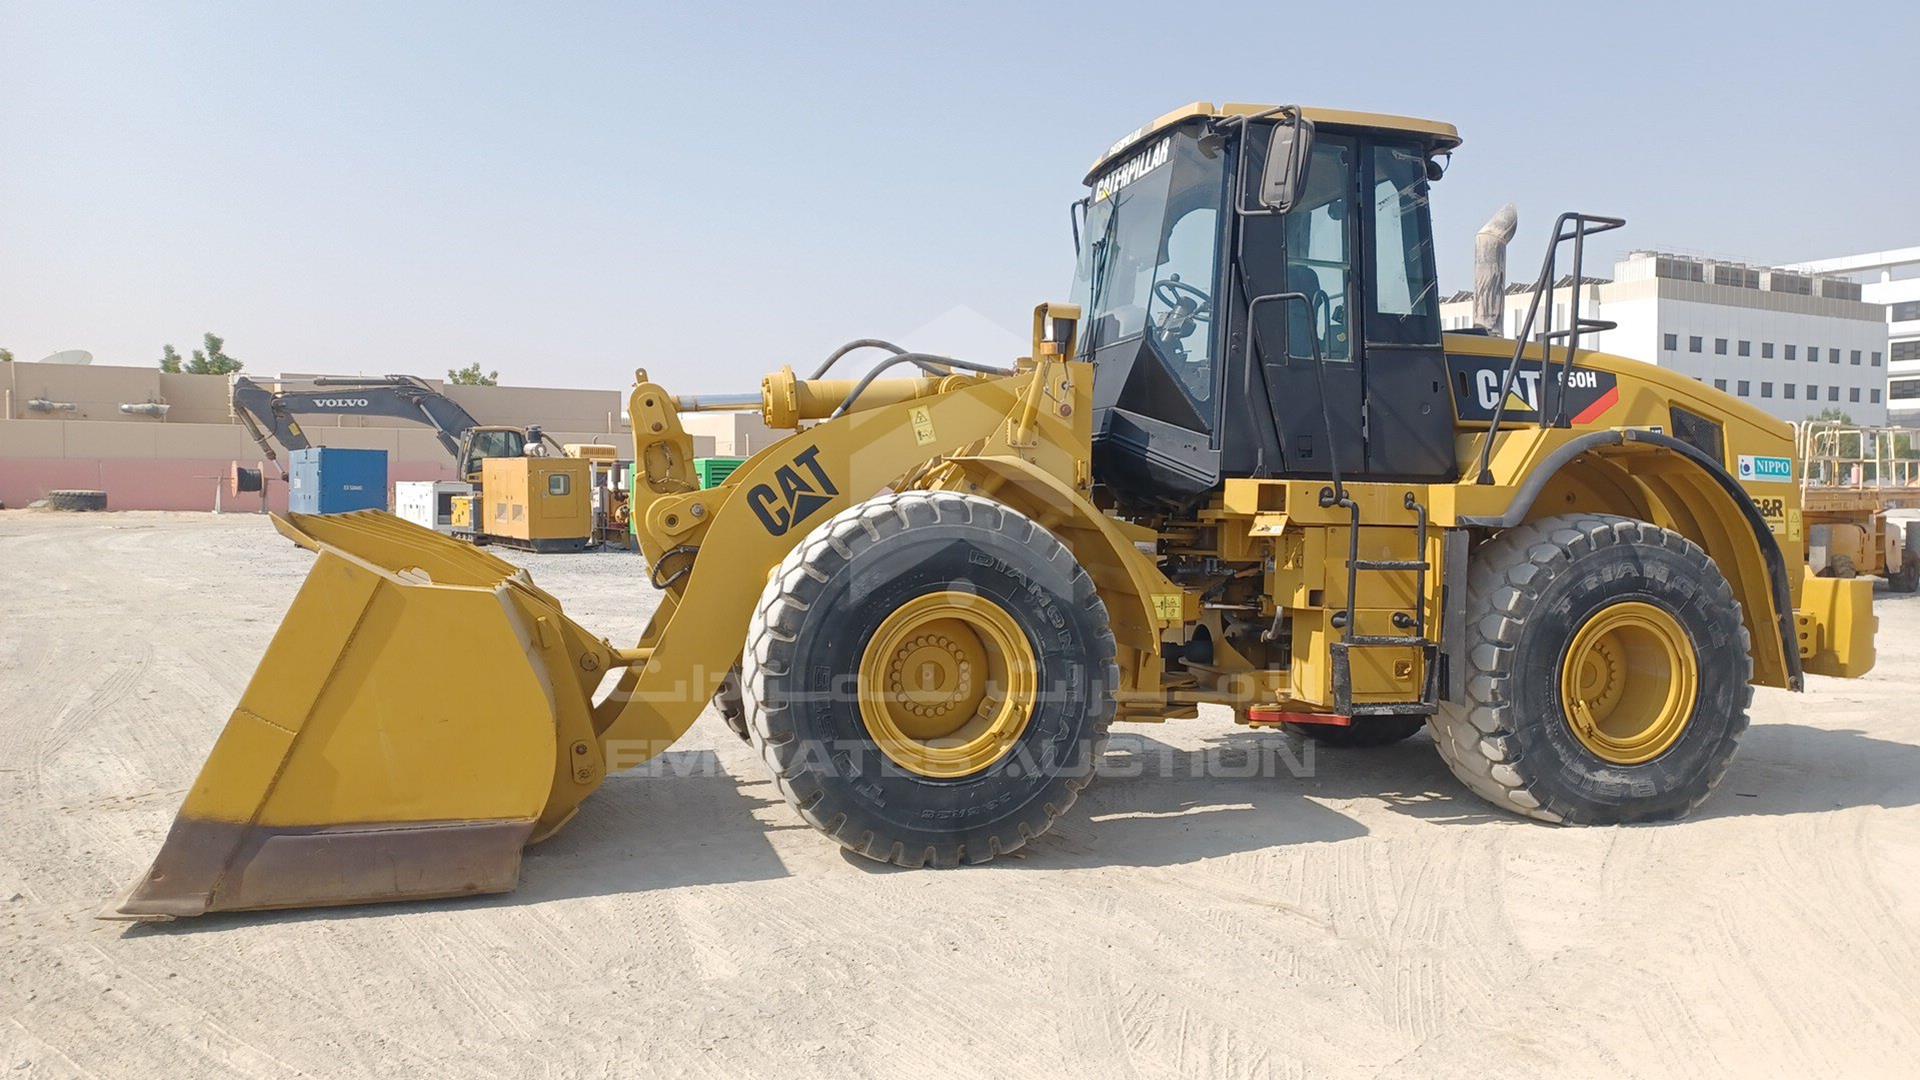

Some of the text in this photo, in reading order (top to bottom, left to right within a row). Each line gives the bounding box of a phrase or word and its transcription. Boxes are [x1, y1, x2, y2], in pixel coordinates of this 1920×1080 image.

[1095, 137, 1170, 203] CATERPILLAR
[313, 399, 368, 407] VOLVO
[1476, 369, 1541, 412] CAT
[1757, 461, 1789, 474] NIPPO
[747, 444, 839, 537] CAT
